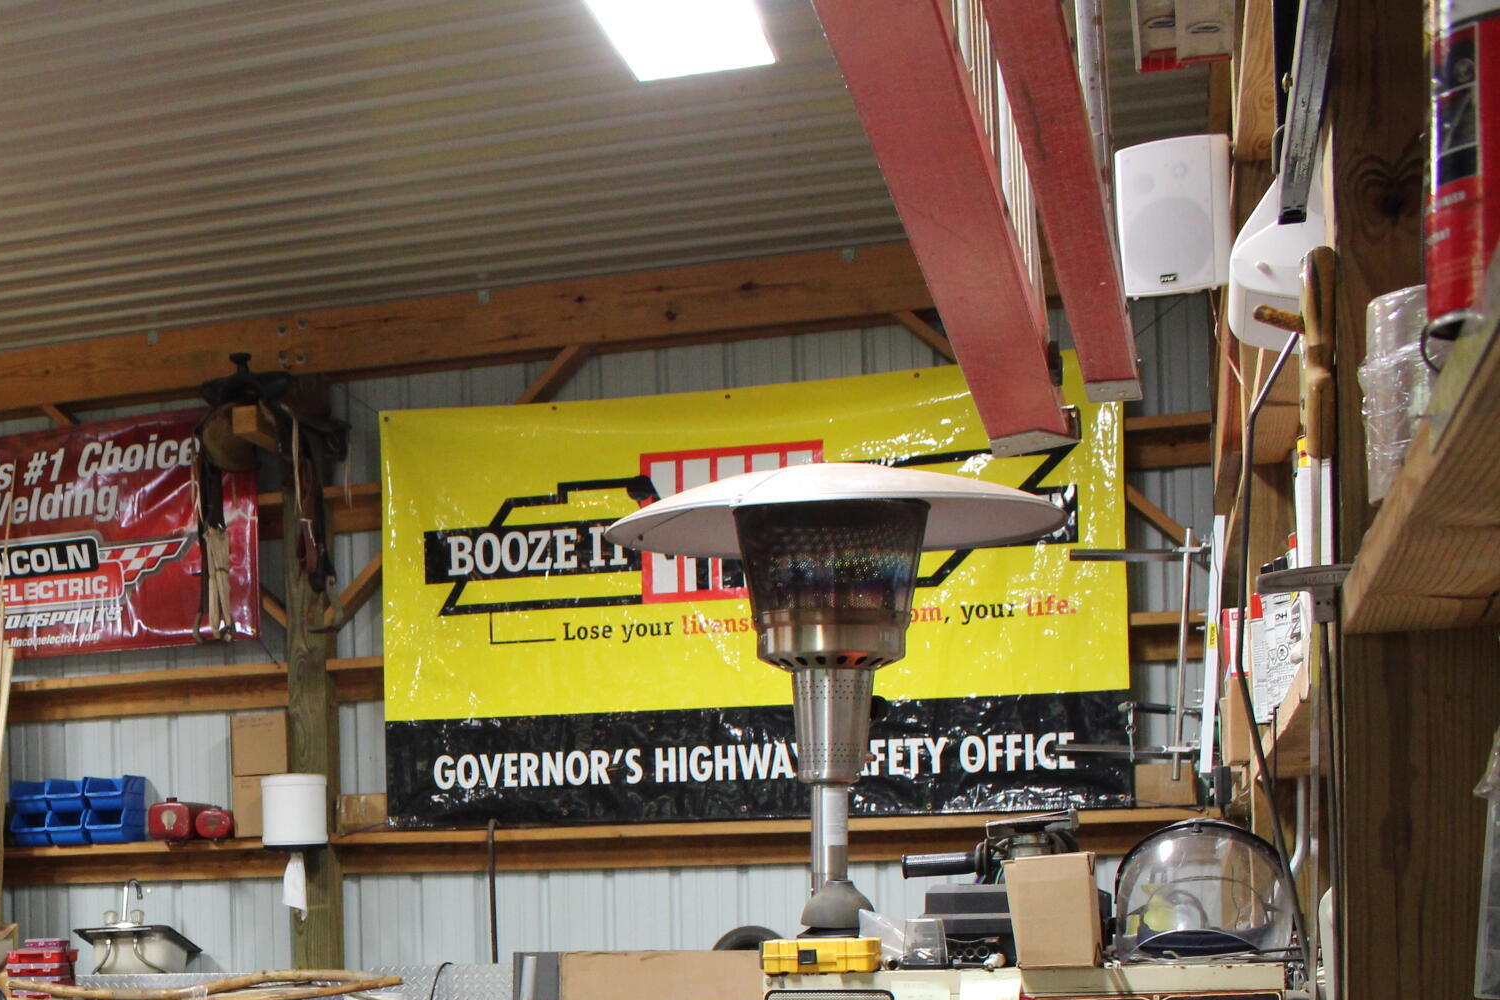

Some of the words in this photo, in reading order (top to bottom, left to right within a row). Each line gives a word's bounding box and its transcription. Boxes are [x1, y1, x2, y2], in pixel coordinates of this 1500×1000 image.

[23, 447, 67, 487] #1
[76, 433, 202, 479] Choice
[447, 527, 578, 577] BOOZE
[563, 621, 613, 641] Lose
[621, 621, 674, 646] your
[960, 602, 1018, 626] your
[1026, 594, 1077, 618] life.
[432, 747, 644, 791] GOVERNOR'S
[859, 736, 948, 777] FETY
[959, 732, 1077, 774] OFFICE
